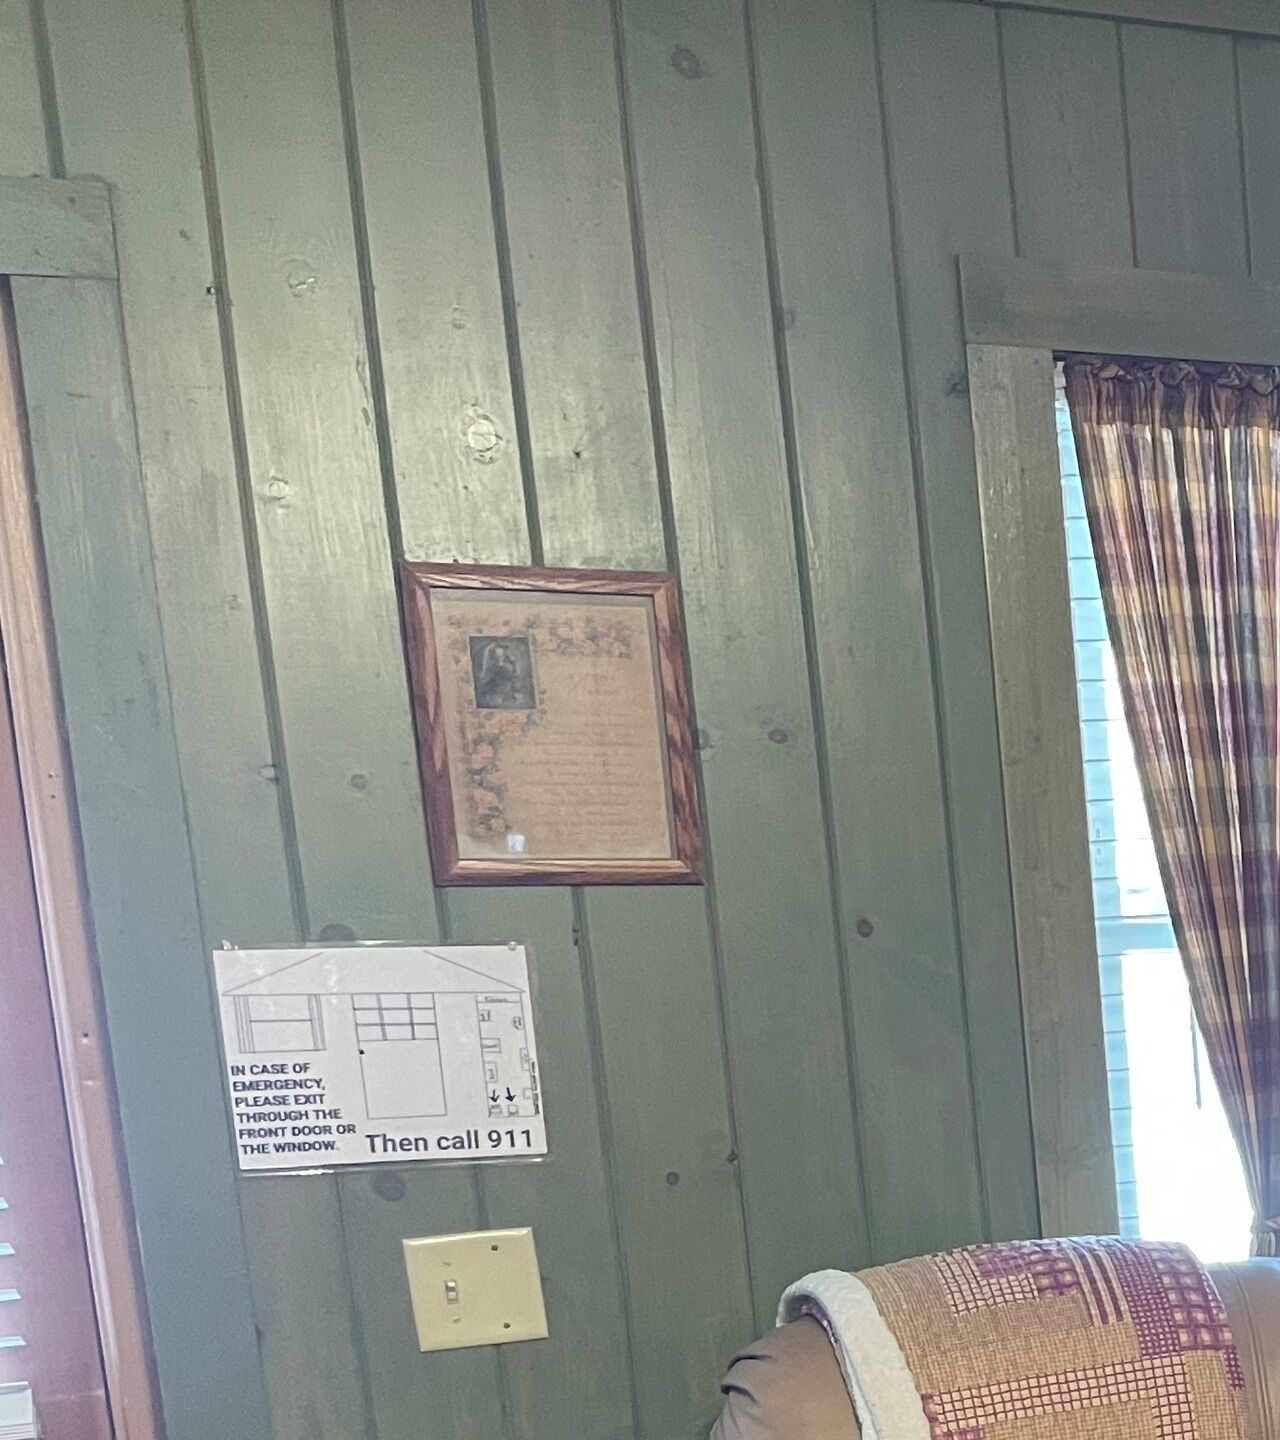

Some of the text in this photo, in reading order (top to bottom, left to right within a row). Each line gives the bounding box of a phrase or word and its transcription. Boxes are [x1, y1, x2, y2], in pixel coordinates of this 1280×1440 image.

[231, 1062, 311, 1076] IN CASE OF
[233, 1078, 325, 1092] EMERGENCY,
[234, 1093, 325, 1108] PLEASE EXIT
[236, 1108, 342, 1124] THROUGH THE
[239, 1123, 356, 1139] FRONT DOOR OR
[240, 1143, 270, 1155] THE
[365, 1129, 532, 1154] Then call 911
